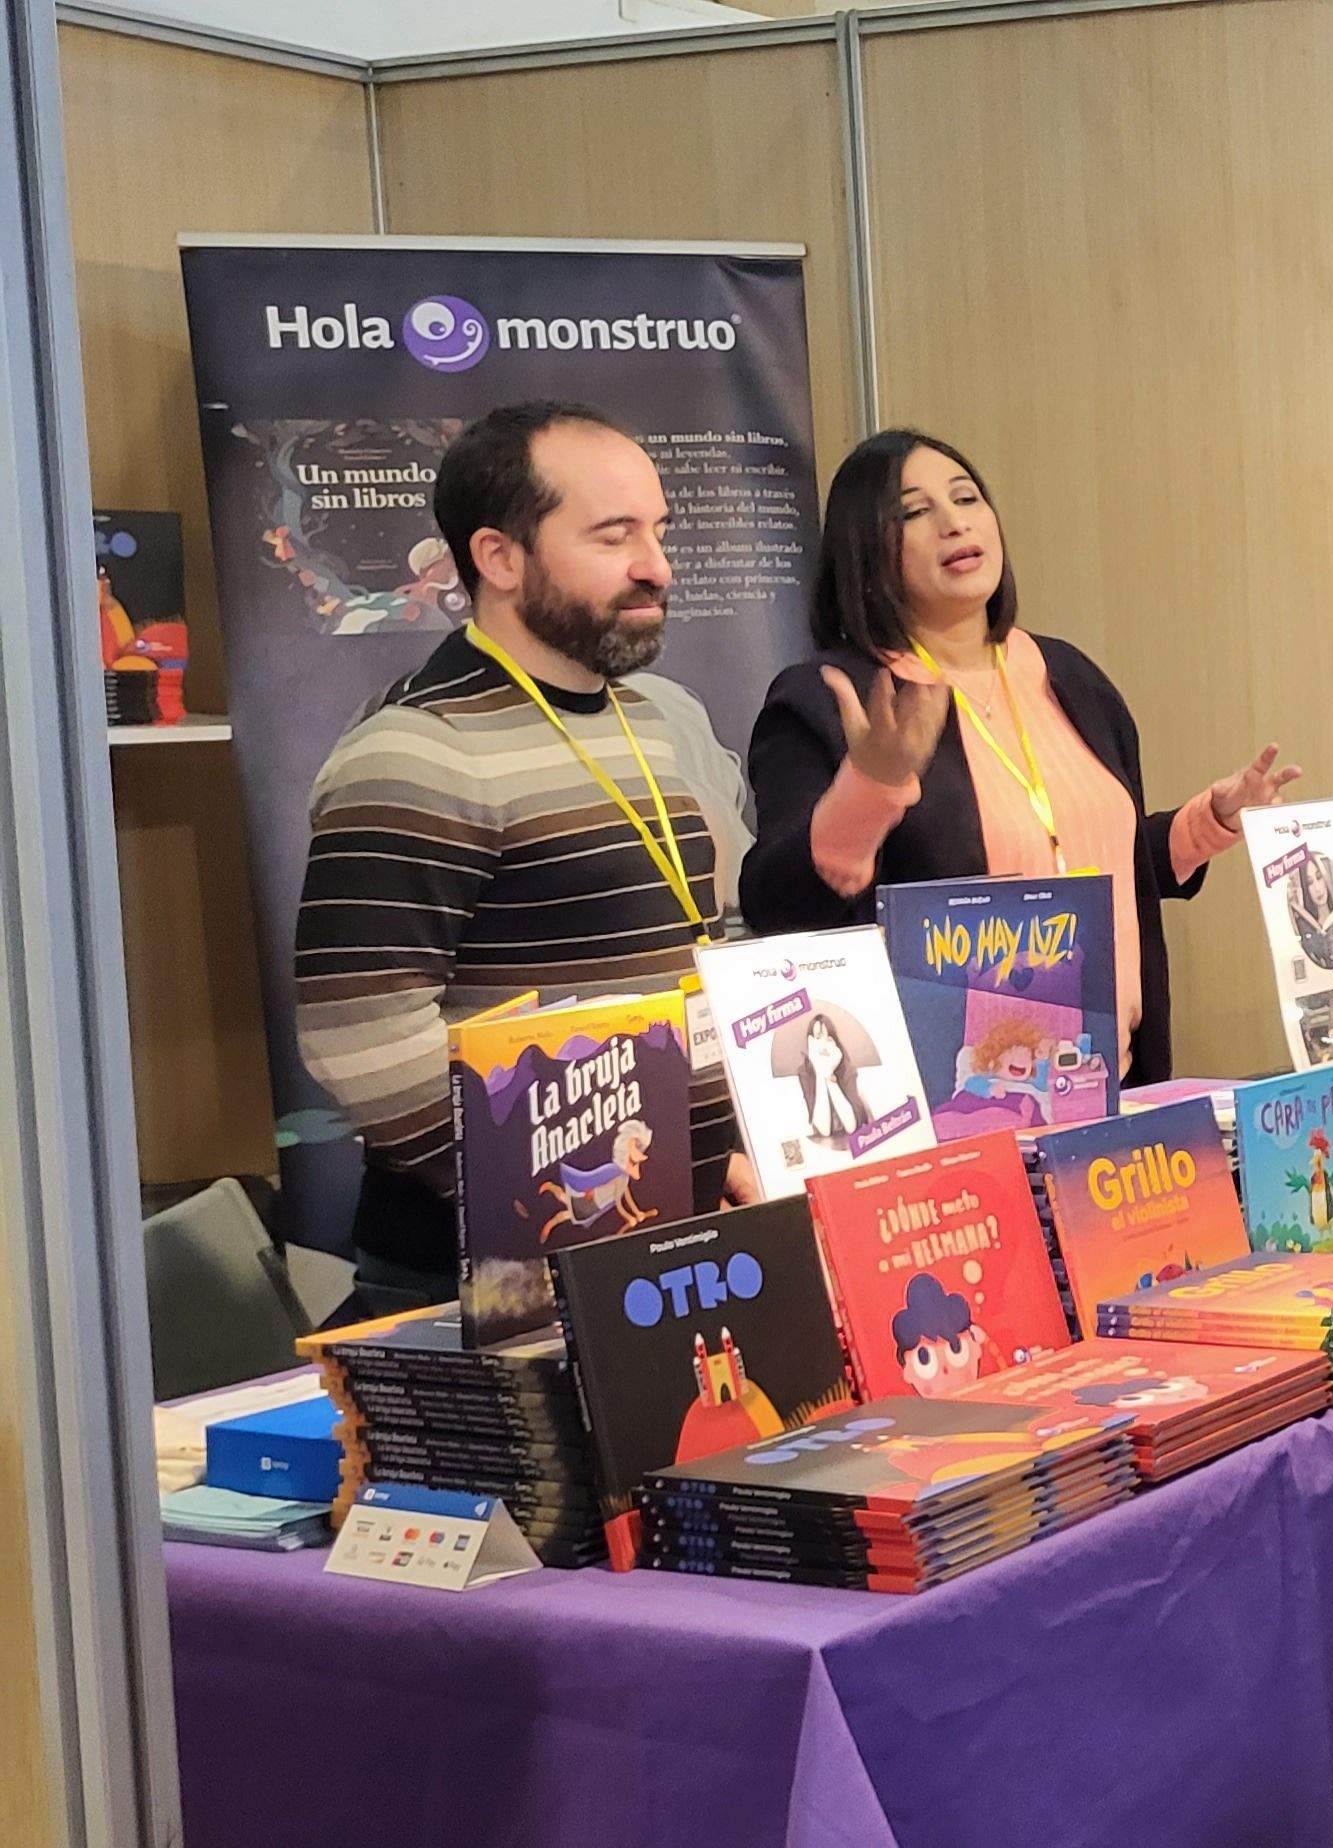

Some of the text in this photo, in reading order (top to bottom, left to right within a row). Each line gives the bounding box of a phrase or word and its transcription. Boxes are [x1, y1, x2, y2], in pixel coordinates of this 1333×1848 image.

[265, 303, 737, 352] Hola monstruo
[648, 432, 667, 444] un
[671, 430, 722, 443] mundo
[725, 430, 745, 443] sin
[296, 461, 438, 486] Un mundo
[703, 462, 729, 475] leer
[311, 487, 427, 510] sin libros
[976, 915, 1024, 989] HAY
[739, 997, 805, 1037] Hoy firma
[528, 1035, 637, 1126] La bruja
[530, 1080, 643, 1178] Anacleta
[1260, 1094, 1304, 1136] CARA
[1087, 1142, 1197, 1211] Grillo
[1110, 1209, 1127, 1232] el
[1127, 1194, 1191, 1227] violinista
[623, 1252, 764, 1328] OTRO
